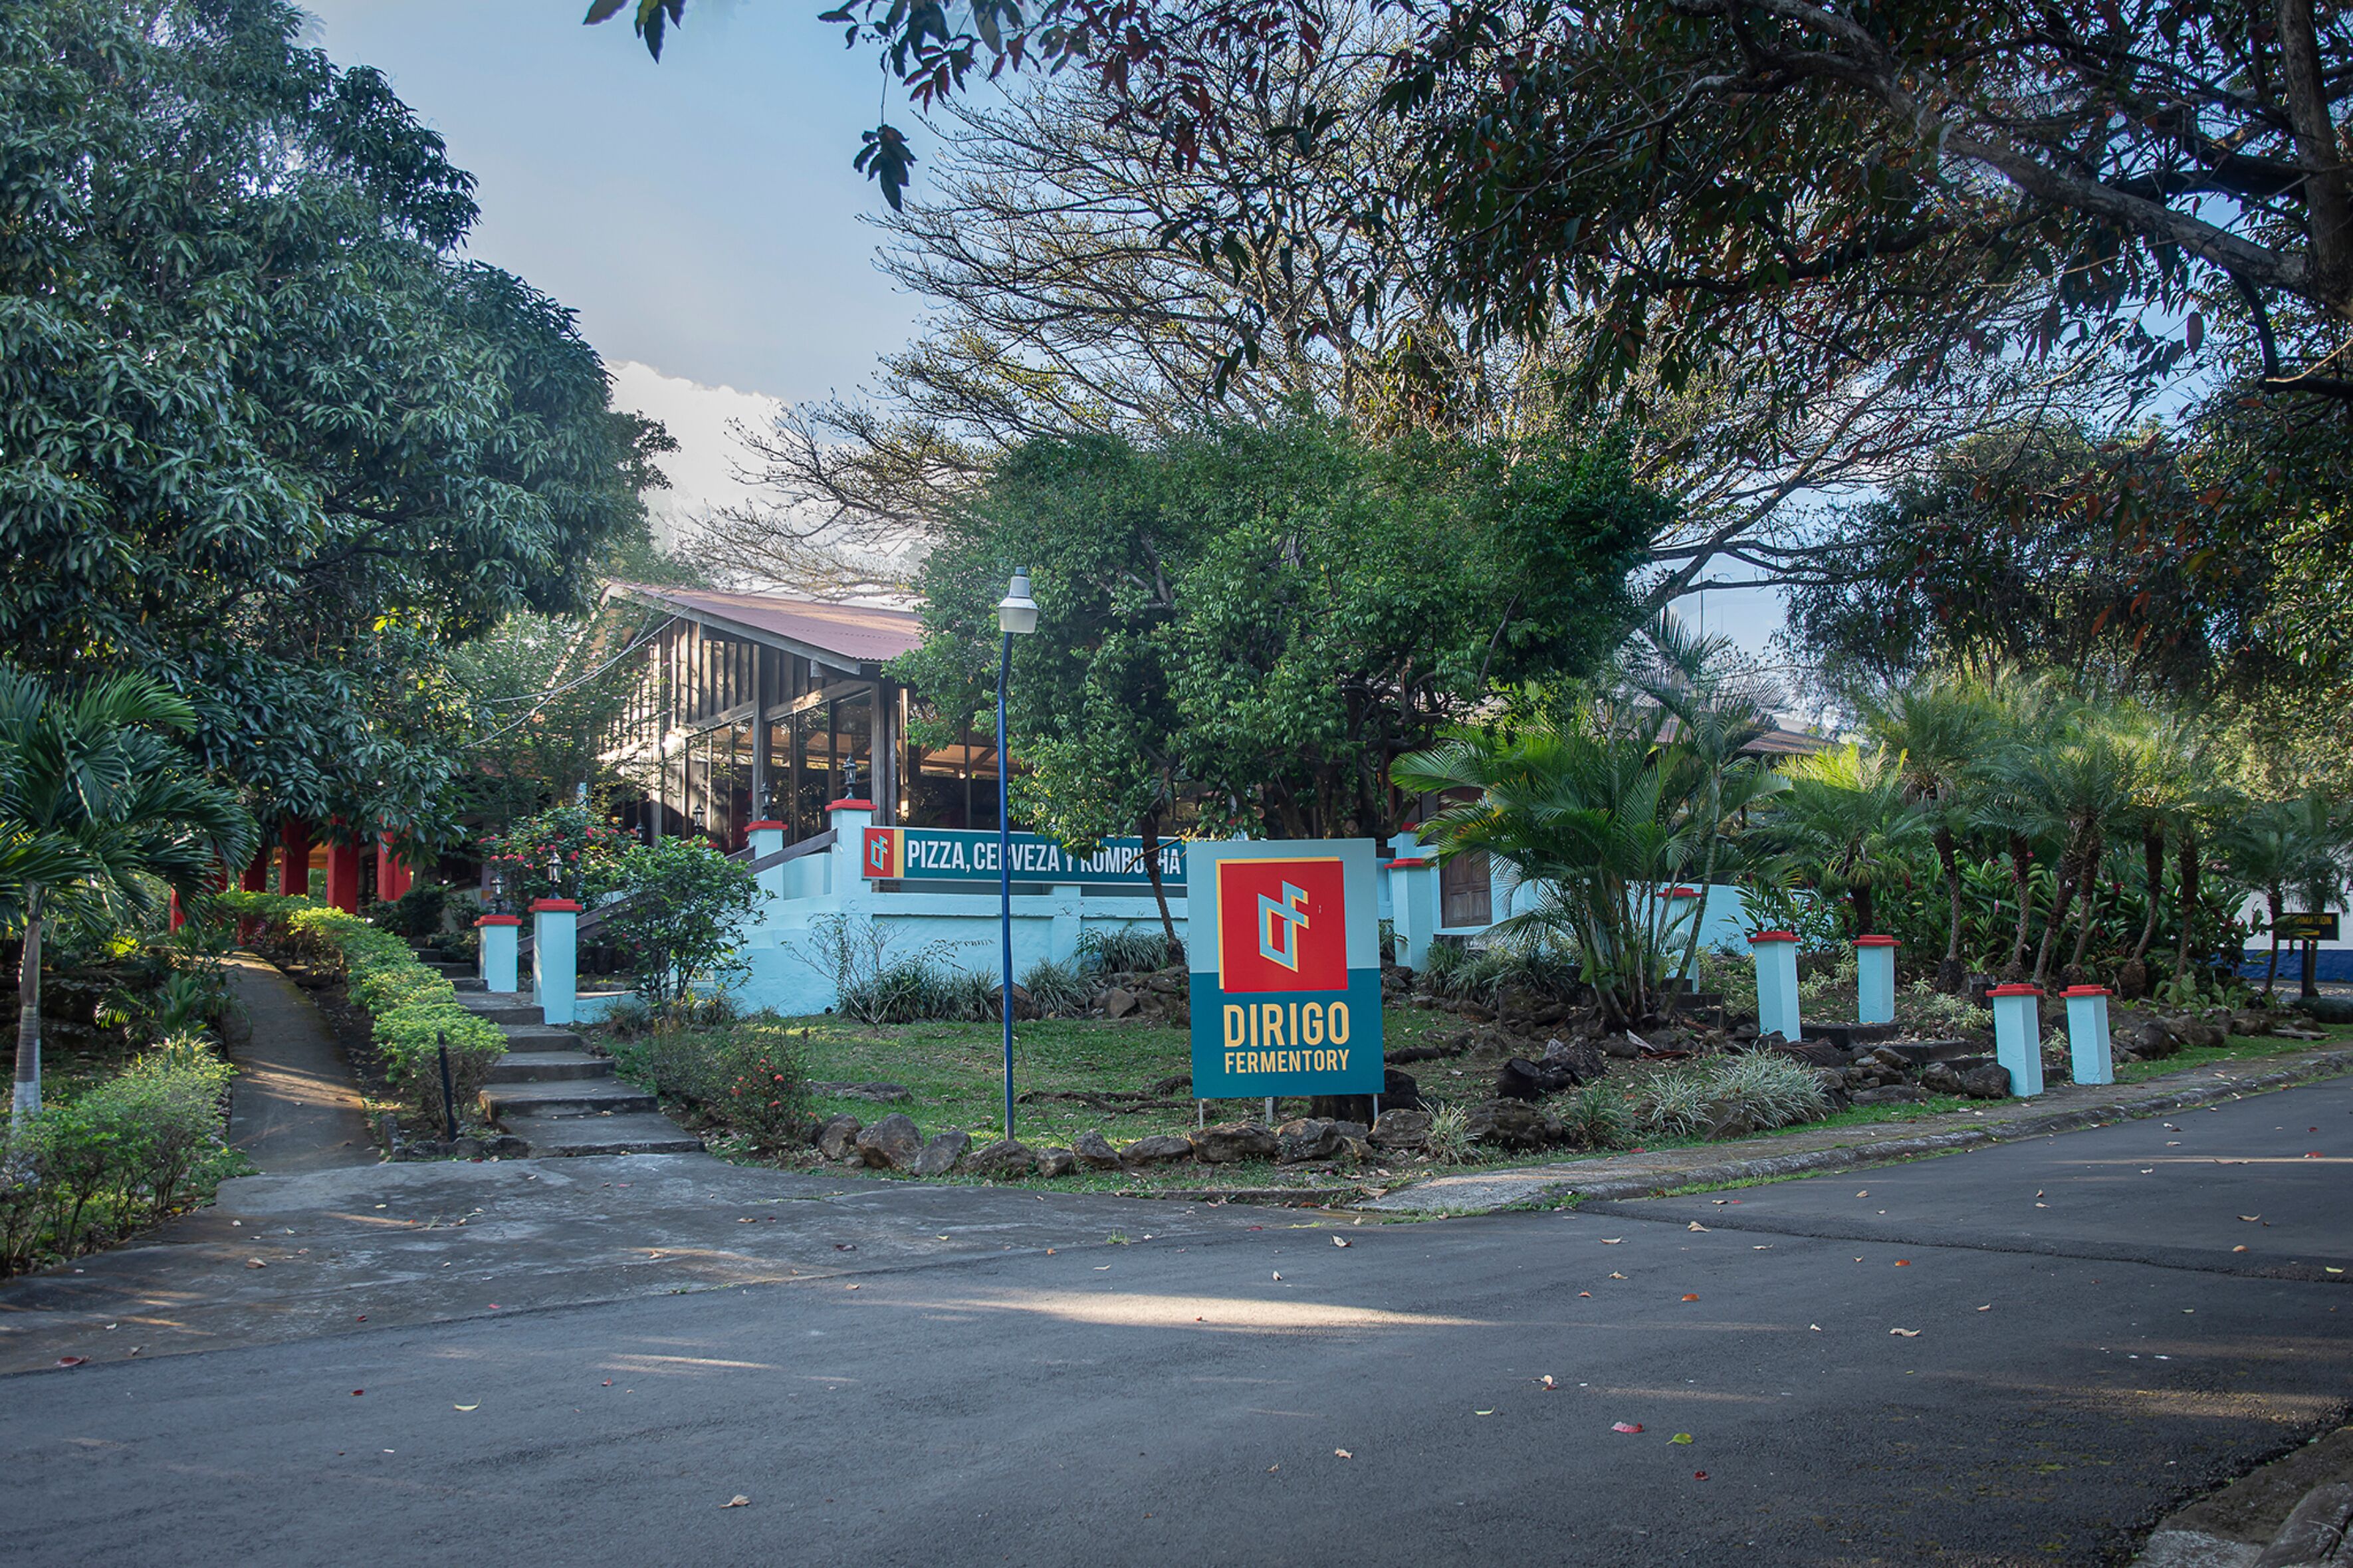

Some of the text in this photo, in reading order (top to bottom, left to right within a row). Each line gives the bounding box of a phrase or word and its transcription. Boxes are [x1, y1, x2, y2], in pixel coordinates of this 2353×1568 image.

[907, 840, 970, 873] PIZZA,
[1080, 845, 1181, 874] KOMBUHA
[1223, 1001, 1350, 1048] DIRIGO
[1224, 1049, 1350, 1074] FERMENTORY
